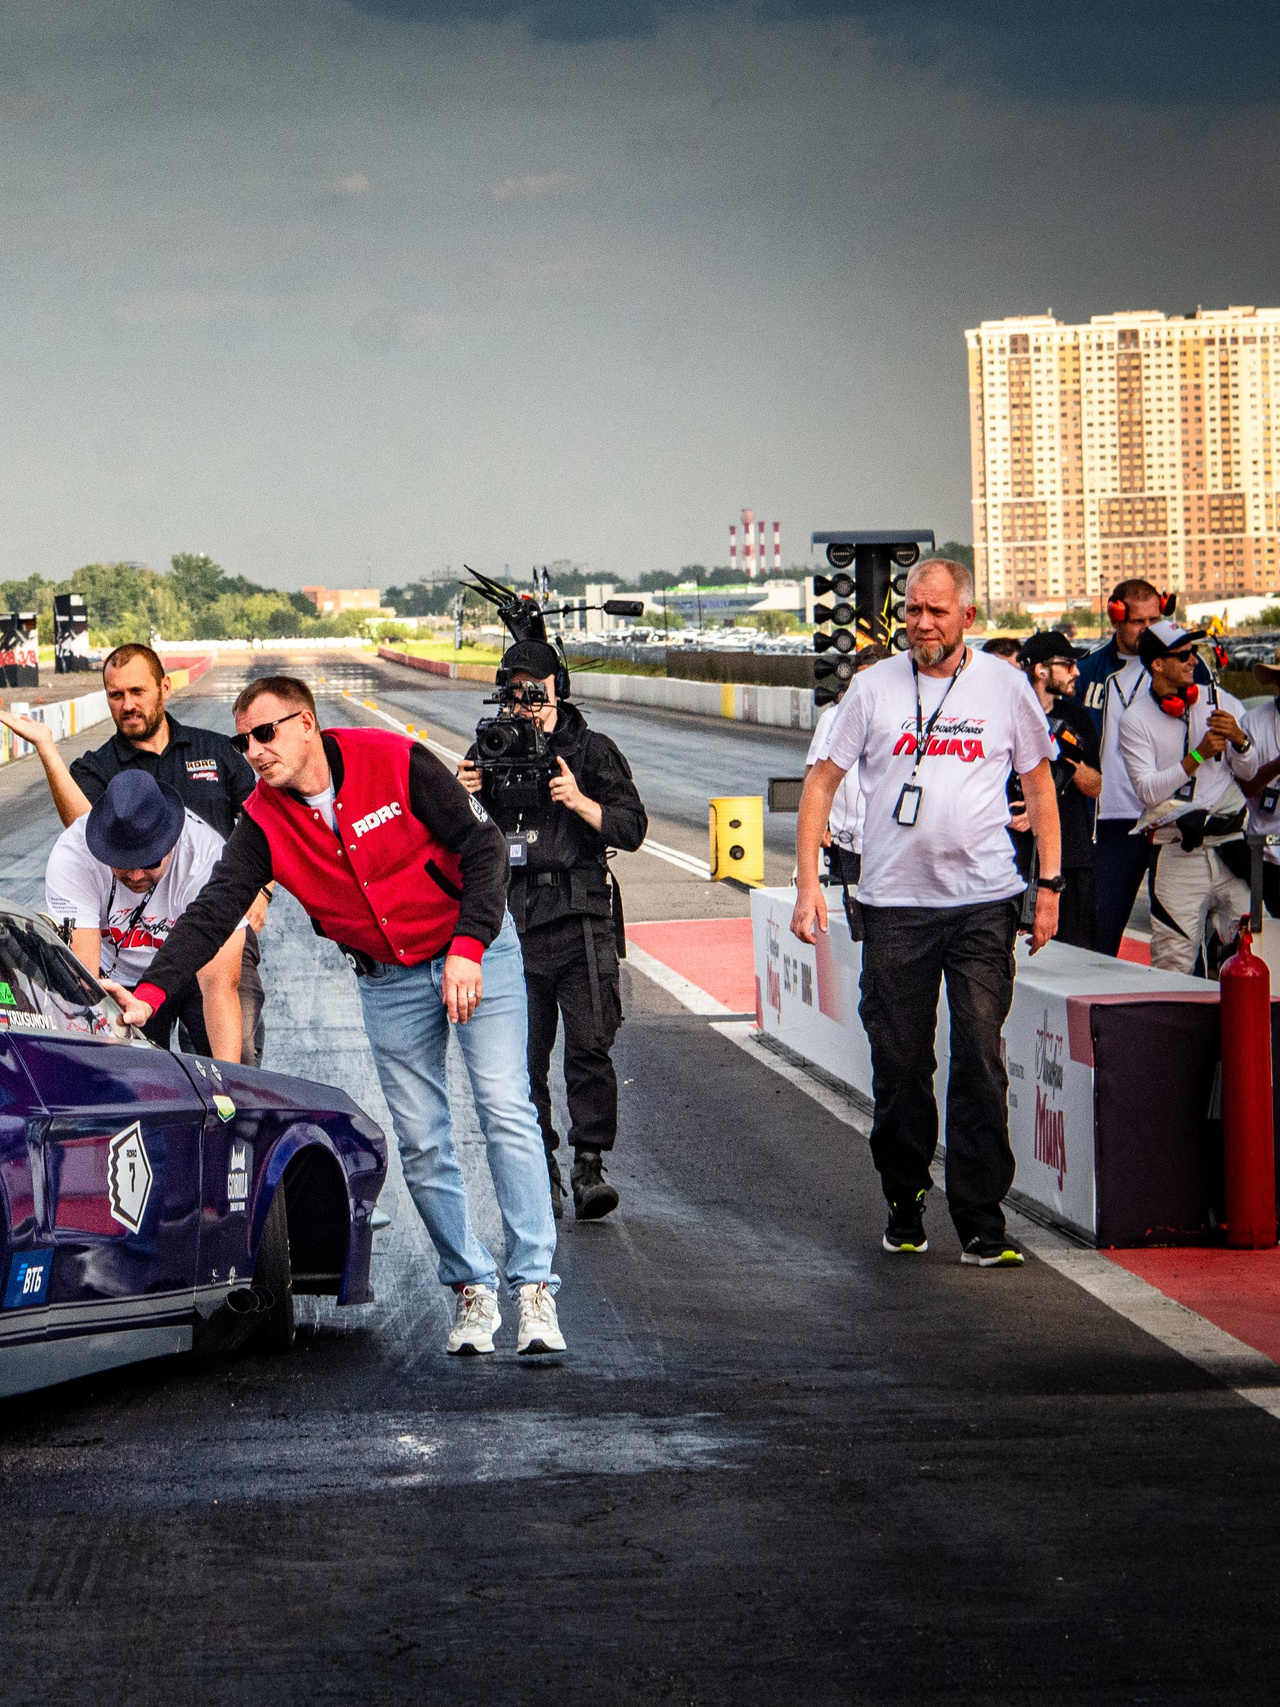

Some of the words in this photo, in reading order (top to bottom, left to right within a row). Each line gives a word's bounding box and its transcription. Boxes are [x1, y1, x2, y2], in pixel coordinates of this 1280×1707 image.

[18, 649, 37, 666] 3/8
[351, 801, 402, 838] RDRC
[129, 1162, 136, 1193] 7
[227, 1172, 248, 1200] GORILLA
[22, 1265, 44, 1294] ВТБ
